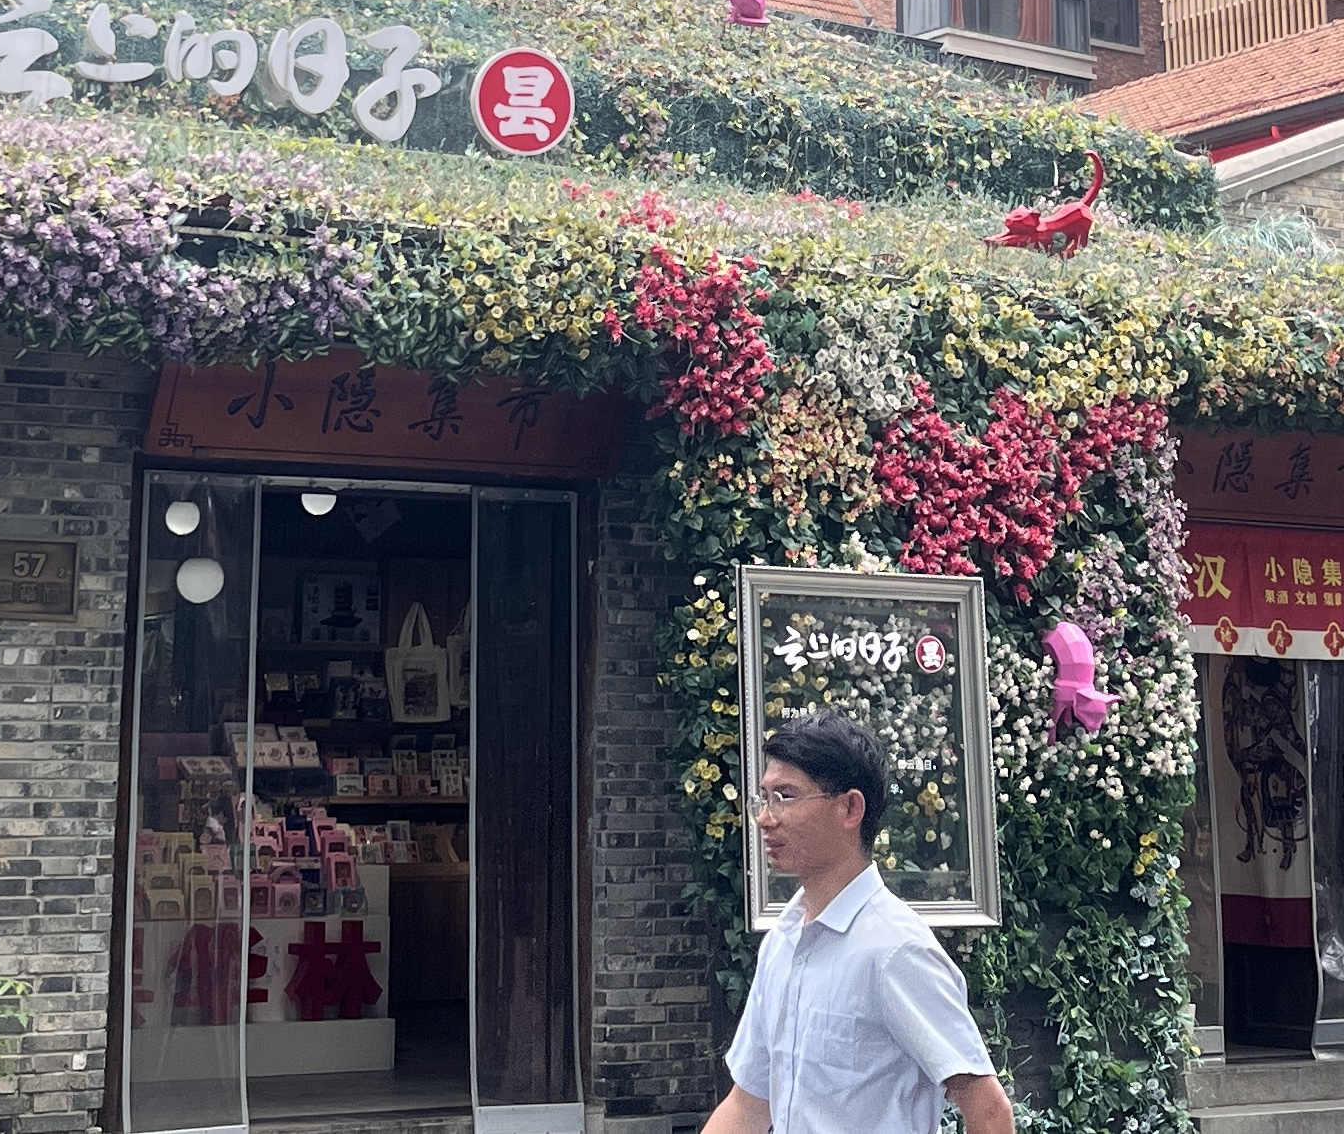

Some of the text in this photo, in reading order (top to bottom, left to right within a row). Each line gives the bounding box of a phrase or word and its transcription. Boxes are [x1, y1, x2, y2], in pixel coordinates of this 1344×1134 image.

[13, 551, 47, 578] 57
[1192, 552, 1232, 600] 汉
[1264, 556, 1344, 587] 小隐集
[773, 625, 908, 672] 云上的日子
